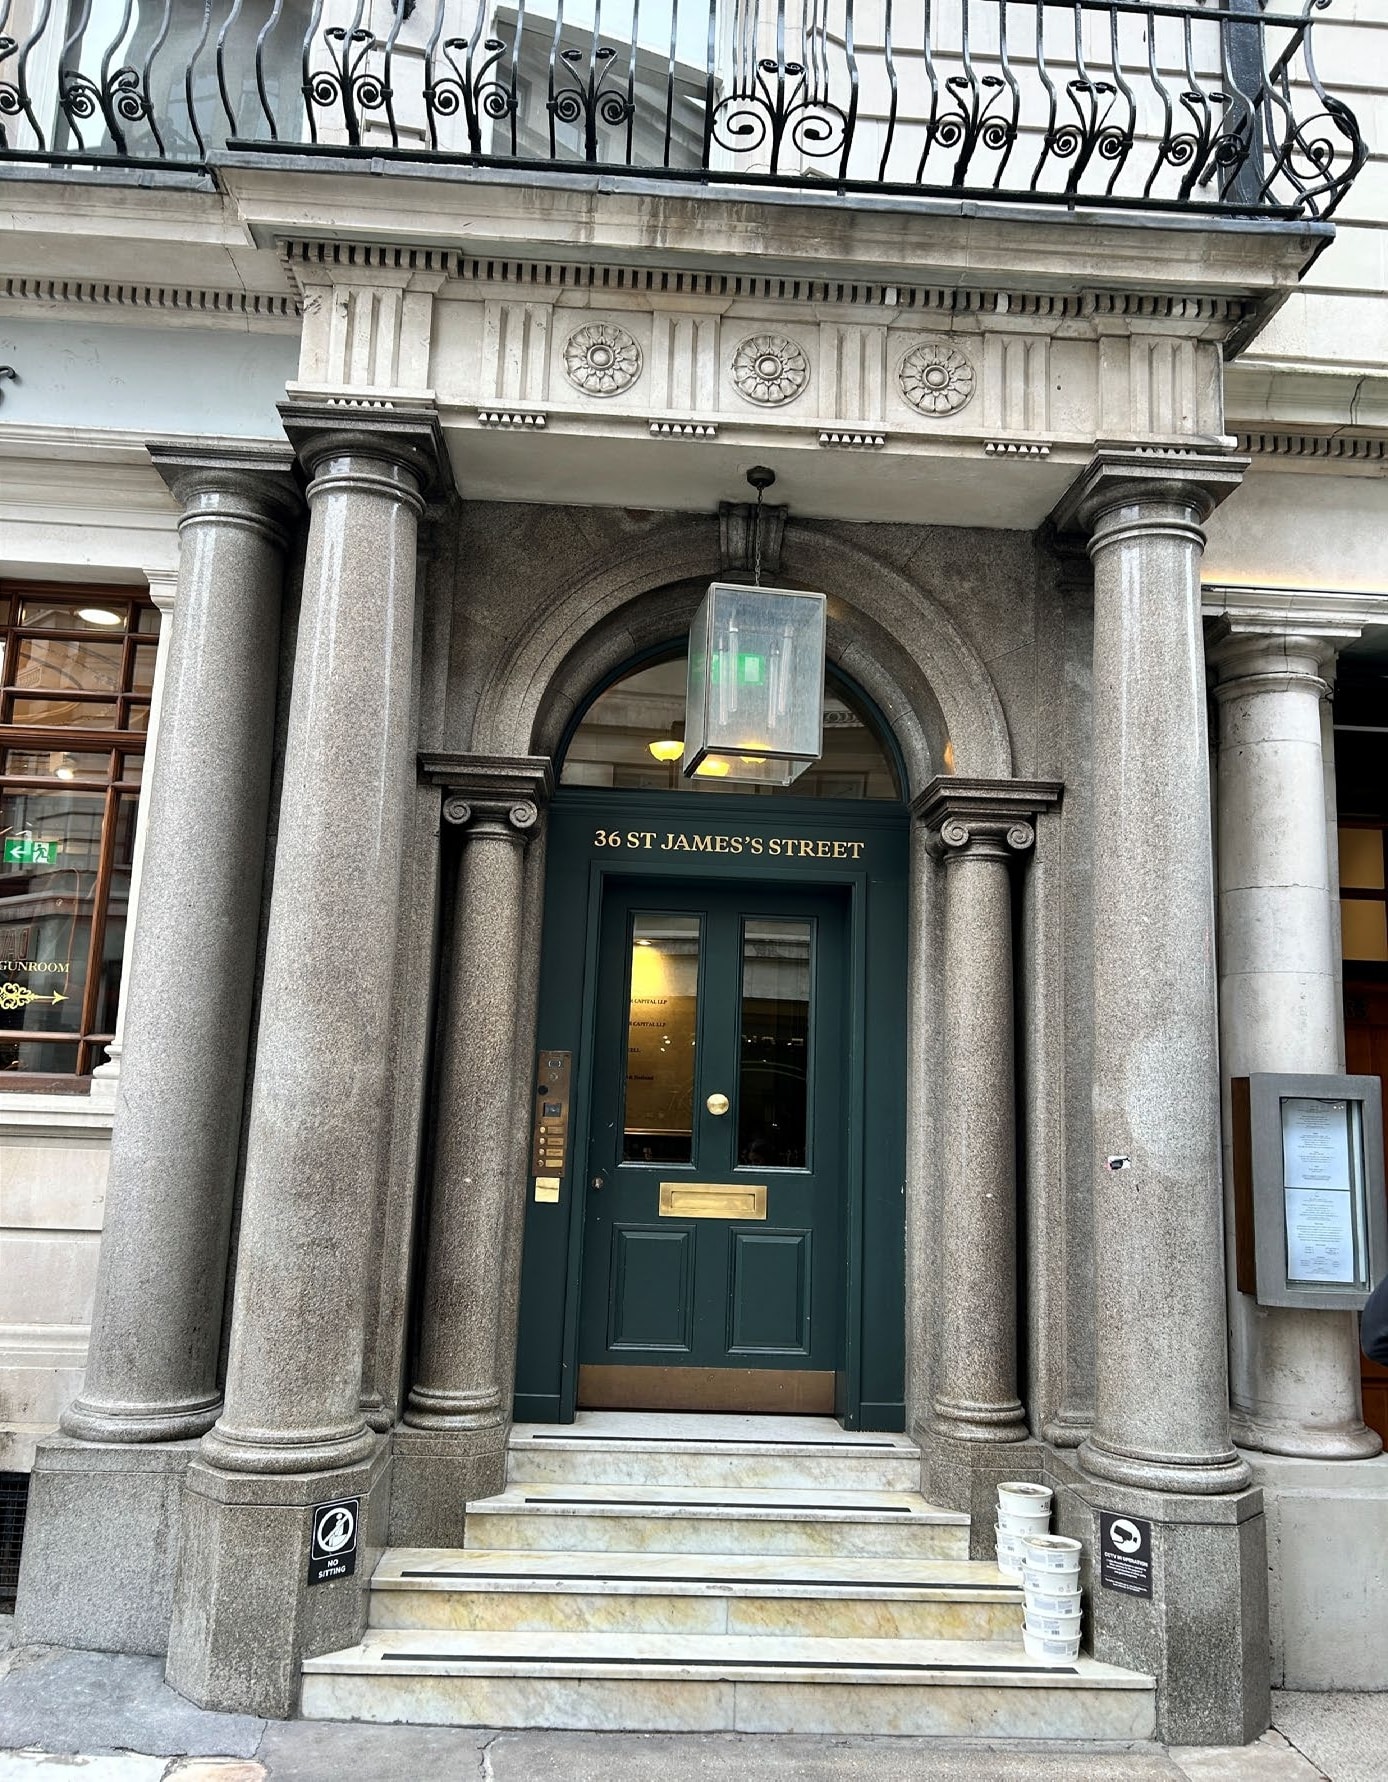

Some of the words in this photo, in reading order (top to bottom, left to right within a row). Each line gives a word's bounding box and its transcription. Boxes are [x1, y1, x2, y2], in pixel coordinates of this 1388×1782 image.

[593, 830, 621, 848] 36
[627, 832, 657, 849] ST
[768, 838, 865, 858] STREET
[0, 960, 70, 973] GUNROOM
[327, 1558, 339, 1568] NO
[1122, 1556, 1149, 1567] OPERATION
[318, 1565, 346, 1578] SITTING
